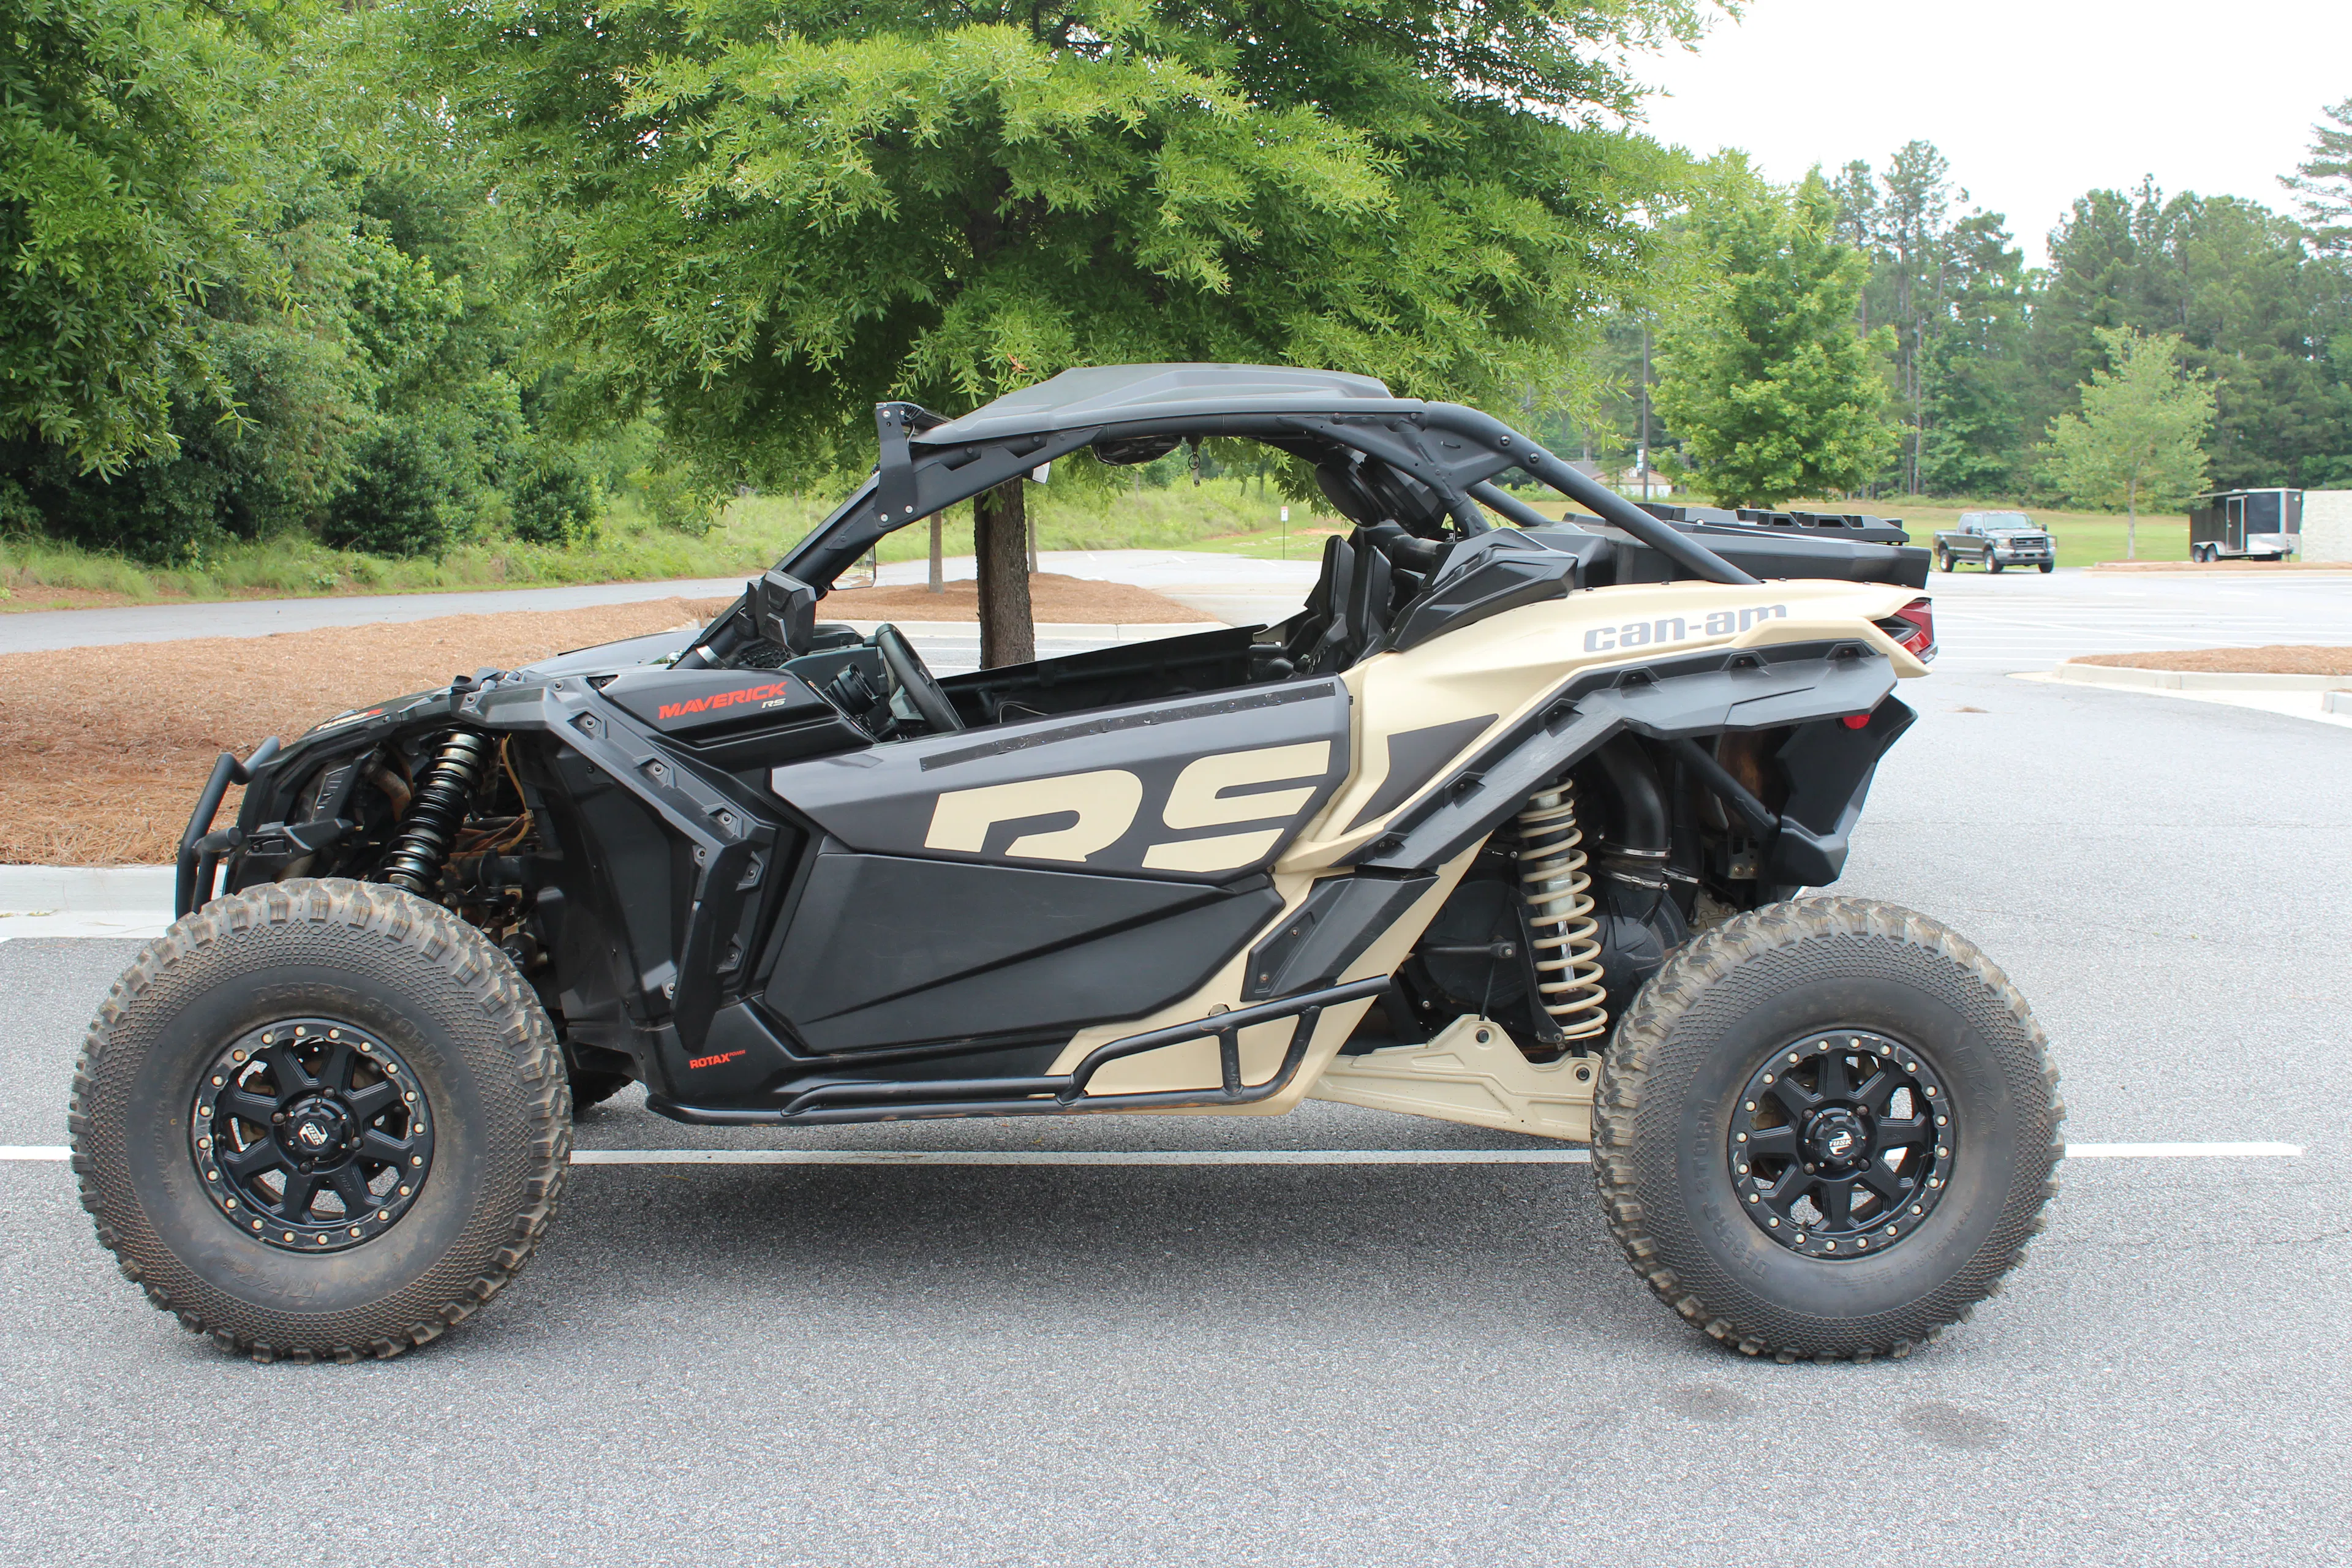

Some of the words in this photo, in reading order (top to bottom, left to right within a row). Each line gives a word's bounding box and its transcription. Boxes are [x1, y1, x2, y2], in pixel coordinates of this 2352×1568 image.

[1584, 604, 1787, 652] can-am
[658, 681, 788, 719] MAVERICK
[761, 698, 786, 709] RS
[924, 740, 1331, 873] RS
[689, 1053, 730, 1069] ROTAX
[305, 1121, 323, 1146] TUSK
[1828, 1139, 1853, 1147] TUSK
